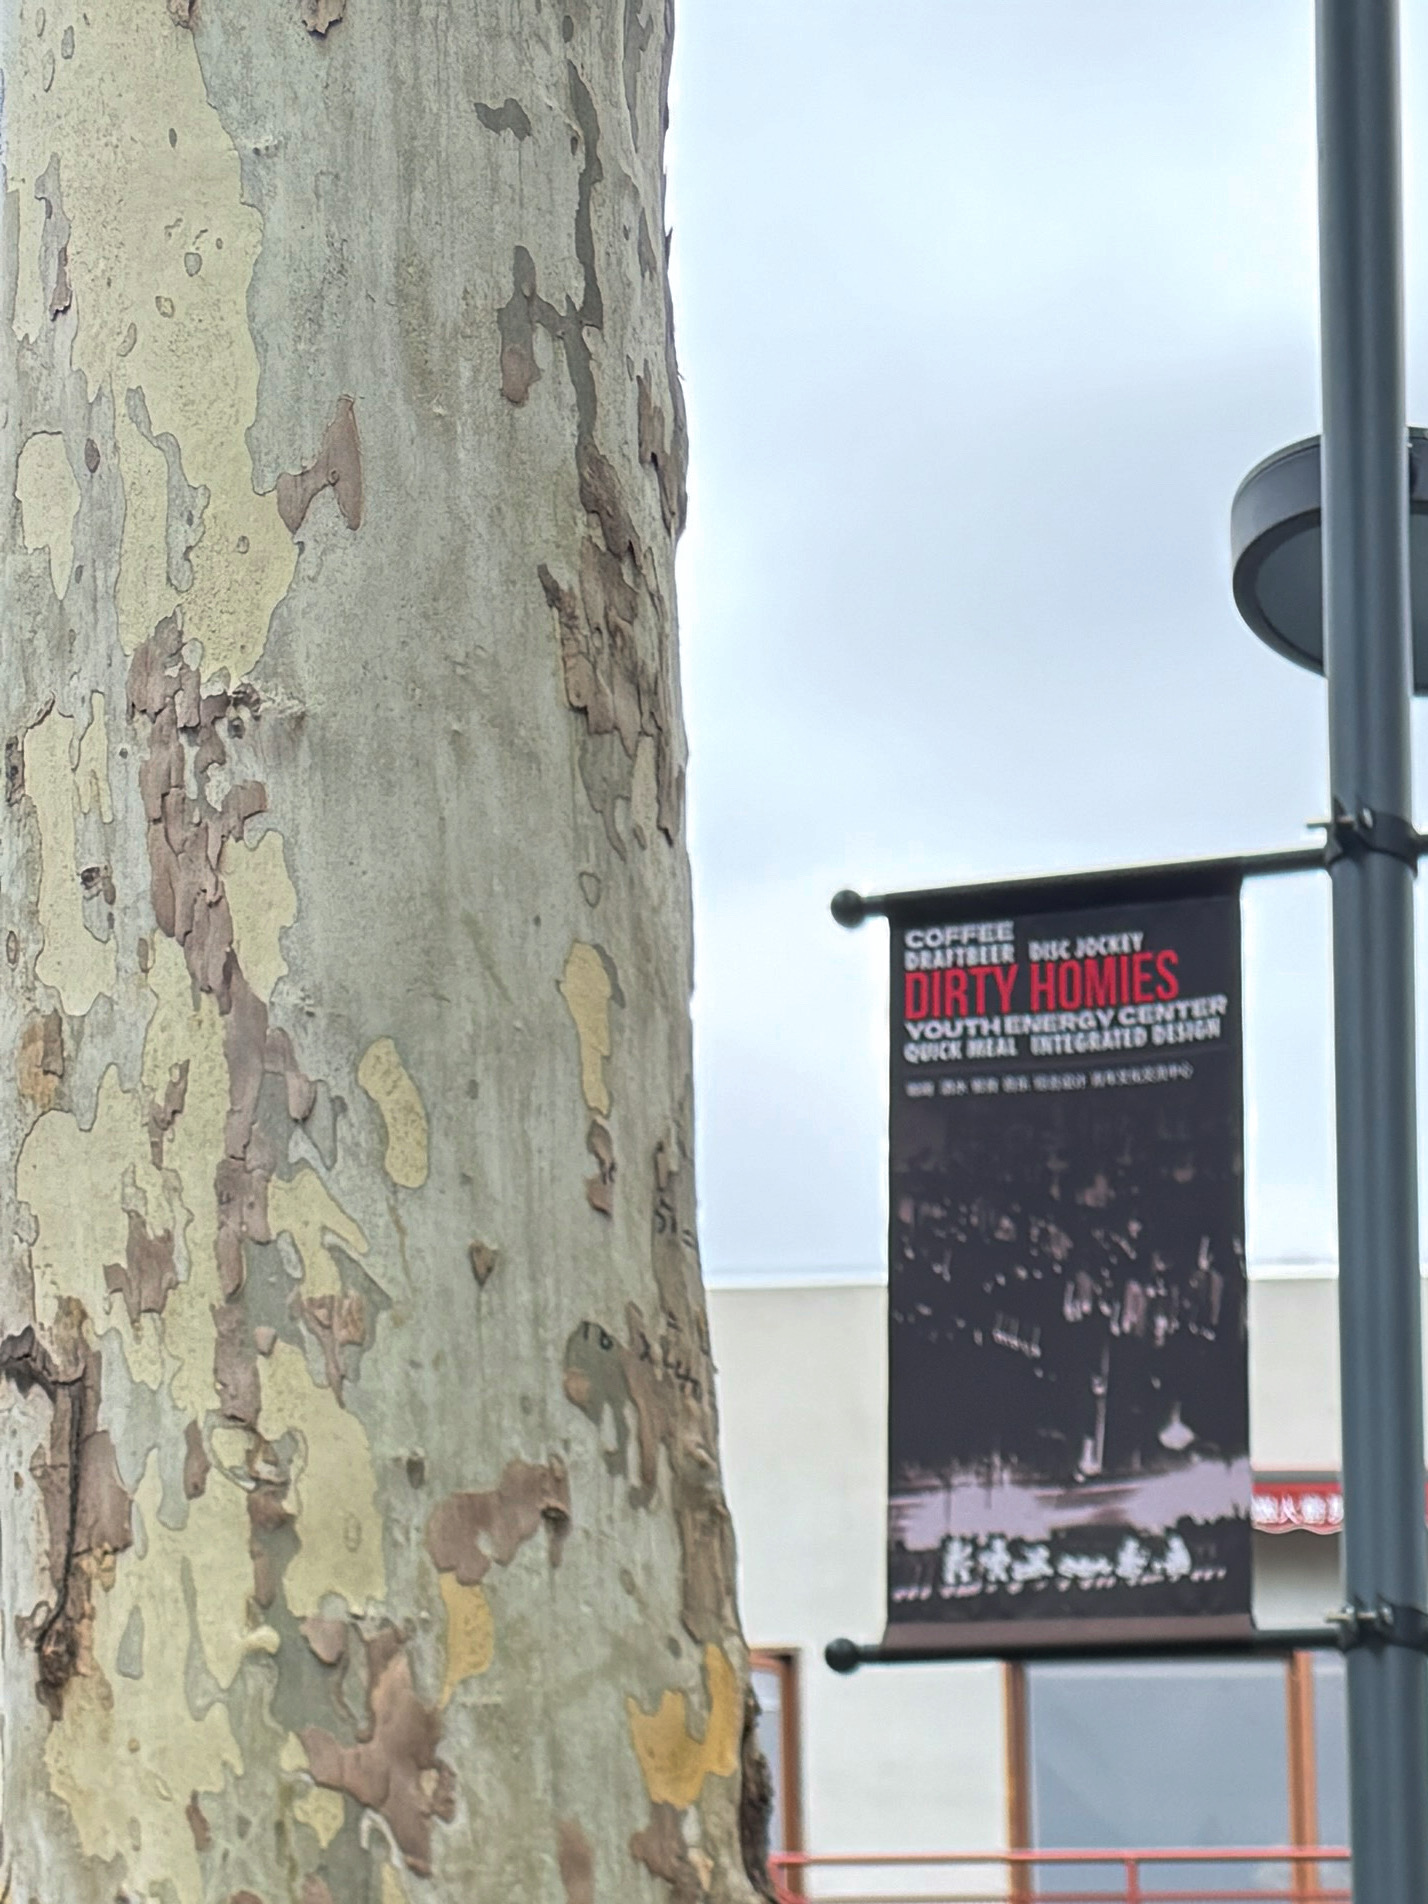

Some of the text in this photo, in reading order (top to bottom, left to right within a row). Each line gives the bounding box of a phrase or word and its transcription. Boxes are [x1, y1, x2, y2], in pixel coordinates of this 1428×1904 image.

[904, 920, 1015, 948] COFFEE
[1075, 931, 1144, 958] JOCKEY
[904, 949, 1179, 1020] DIRTY HOMIES
[904, 994, 1228, 1041] YOUTH ENERGY CENTER
[904, 1017, 1221, 1063] QUICK MEAL INTEGRATED DESIGN
